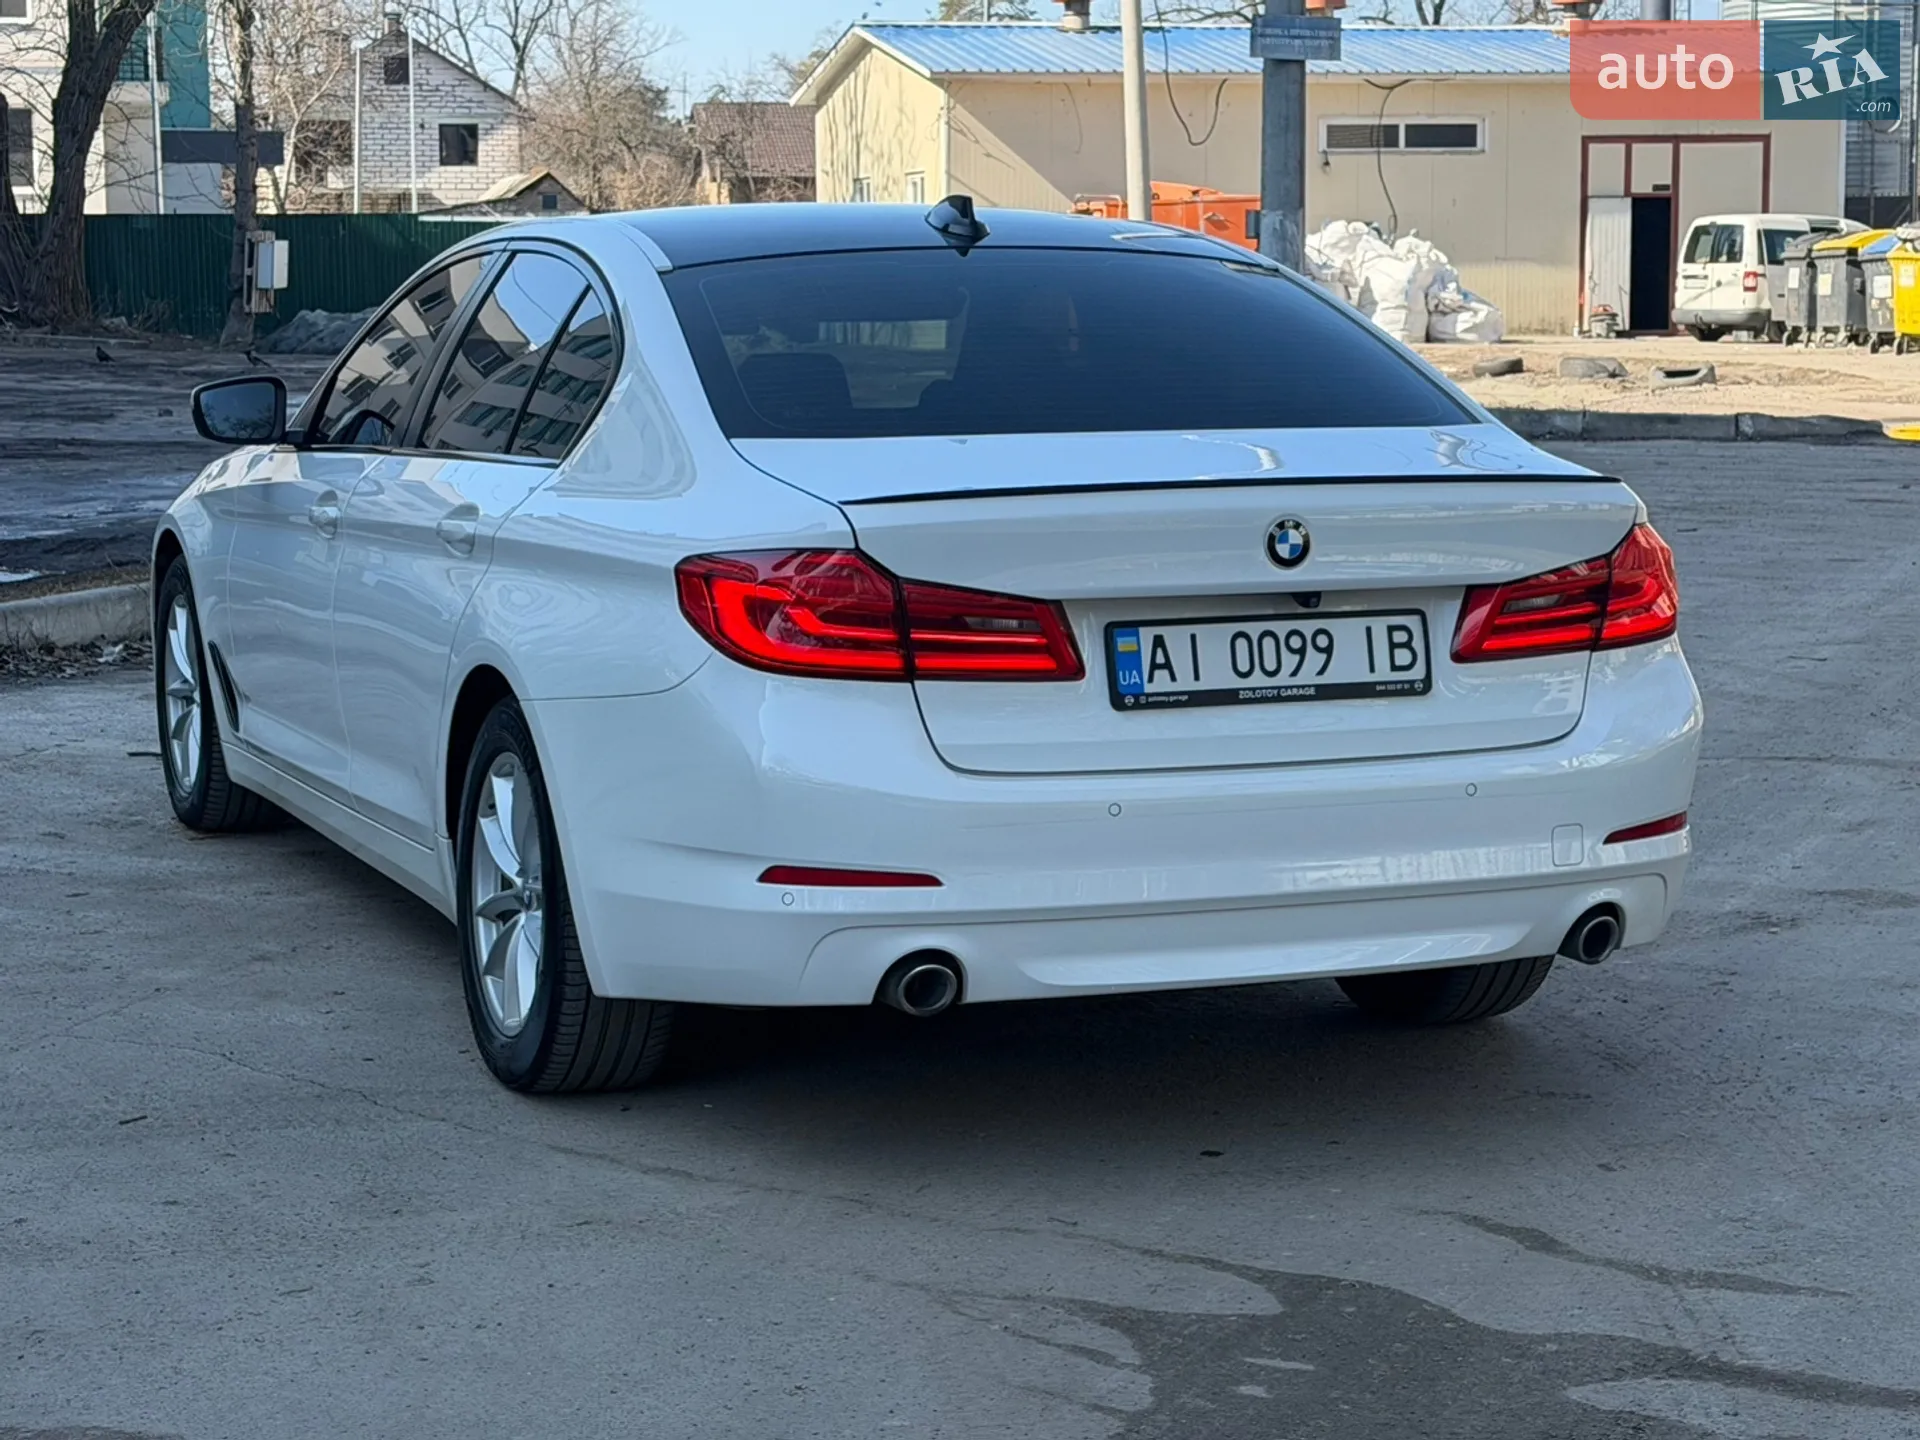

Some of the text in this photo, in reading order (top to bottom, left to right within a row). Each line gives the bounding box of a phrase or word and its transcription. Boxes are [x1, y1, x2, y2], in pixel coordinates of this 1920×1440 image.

[1147, 624, 1418, 684] AI 0099 IB
[1119, 670, 1141, 685] UA
[1238, 687, 1317, 699] ZOLOTOY GARAGE
